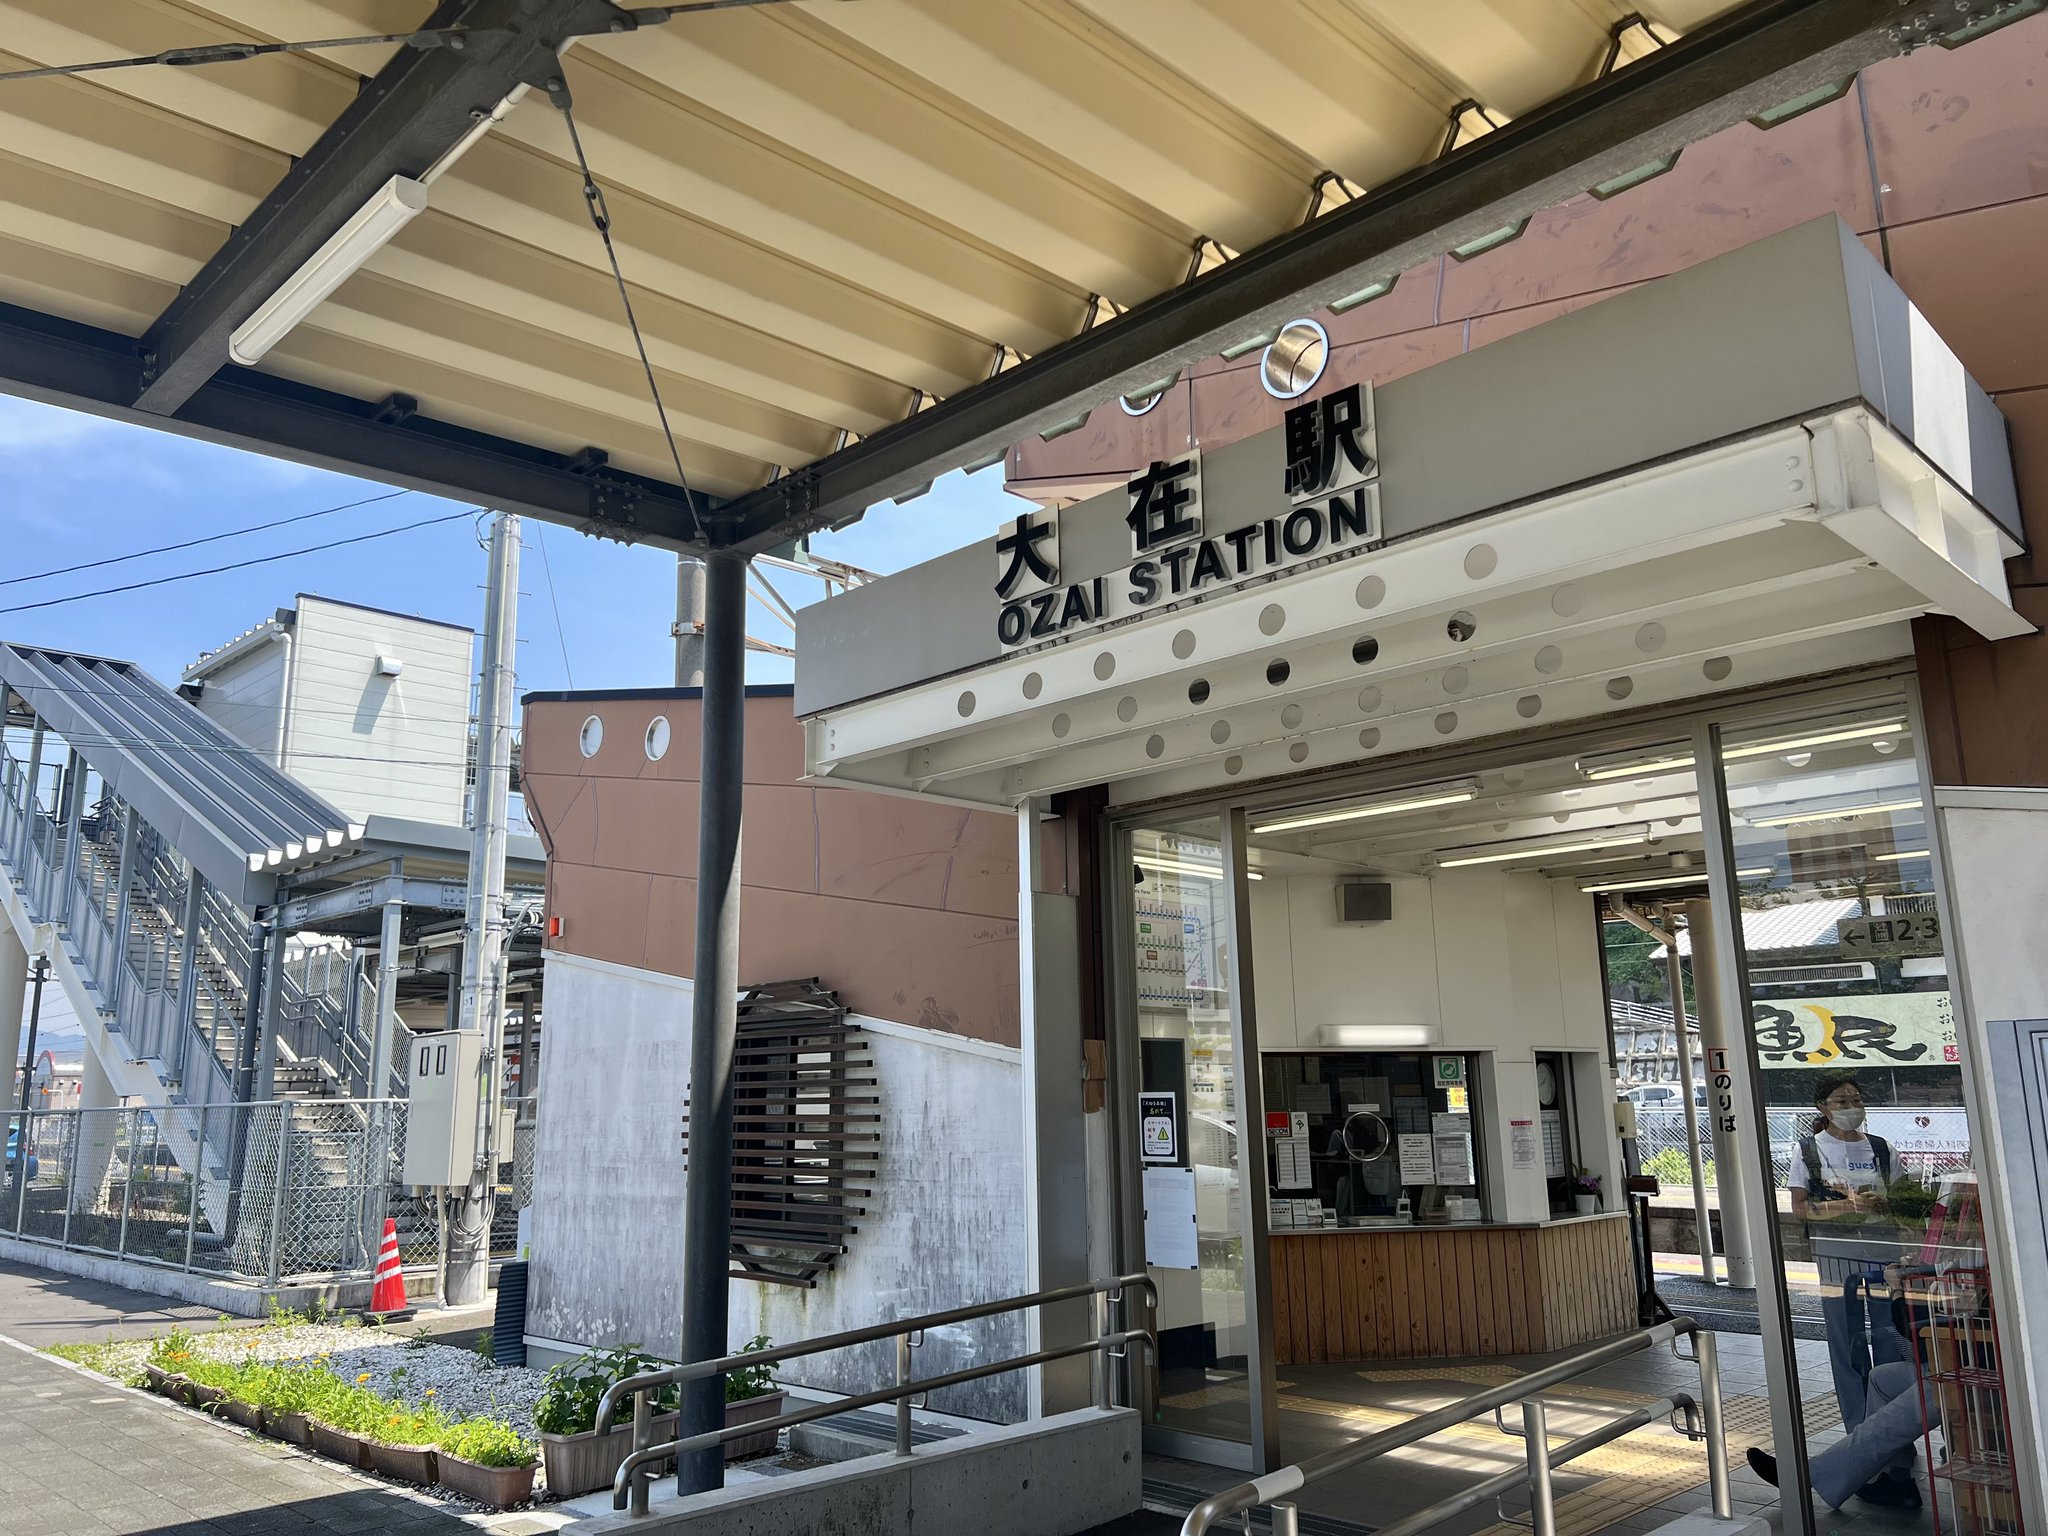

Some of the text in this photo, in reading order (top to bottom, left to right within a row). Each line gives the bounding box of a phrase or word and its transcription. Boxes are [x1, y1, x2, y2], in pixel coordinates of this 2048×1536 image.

[995, 383, 1375, 600] 大在駅
[998, 488, 1374, 646] OZAI STATION
